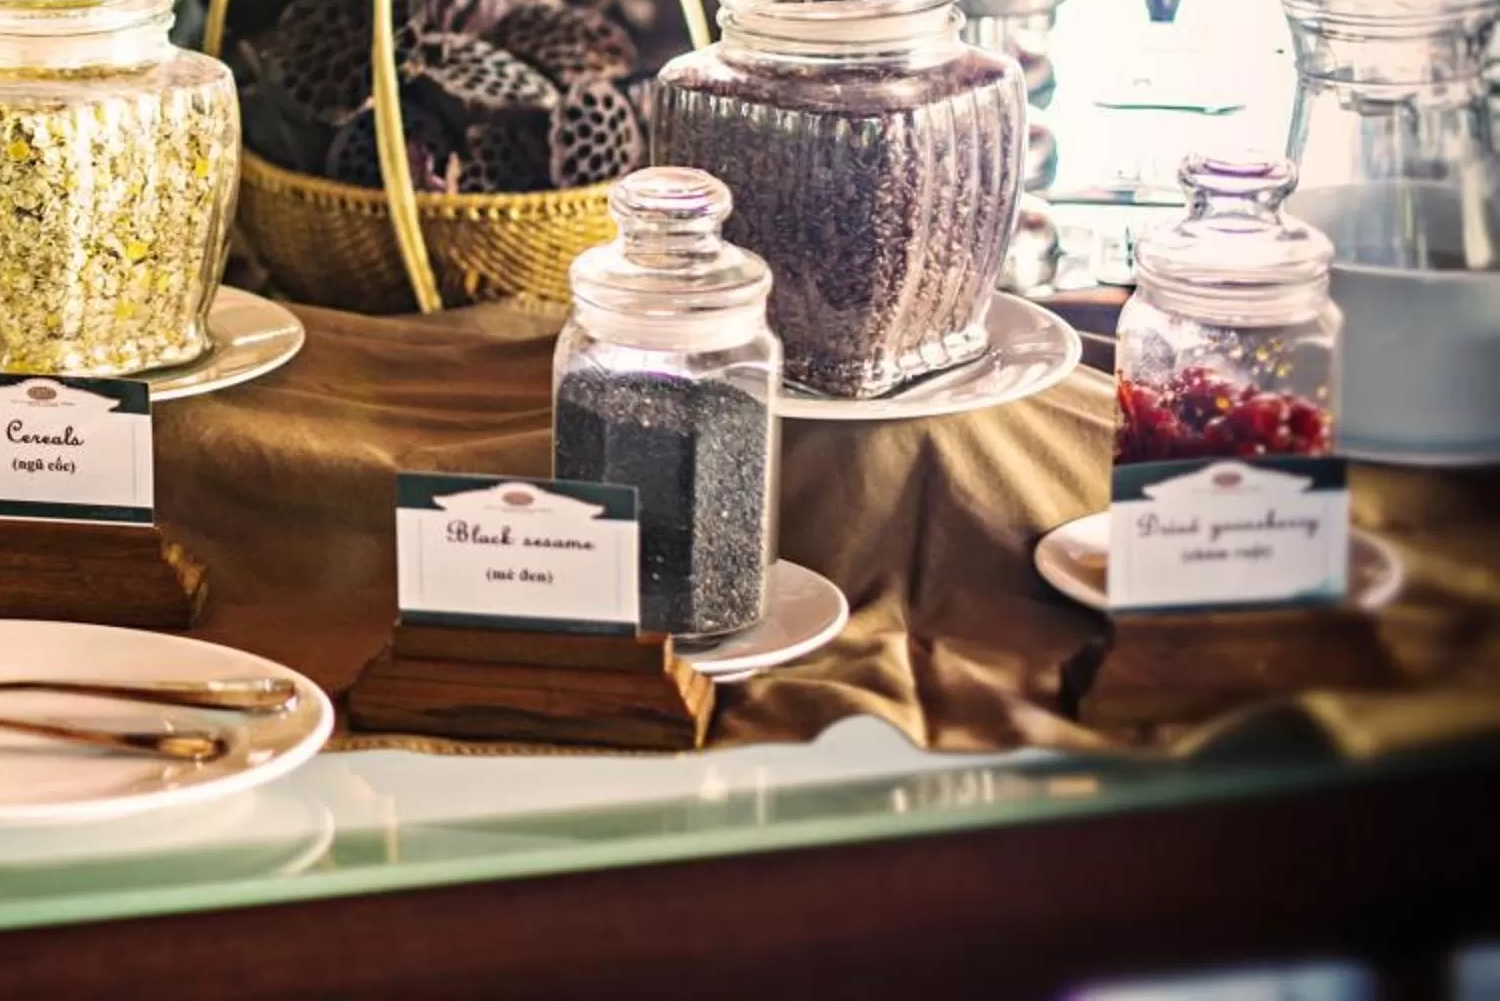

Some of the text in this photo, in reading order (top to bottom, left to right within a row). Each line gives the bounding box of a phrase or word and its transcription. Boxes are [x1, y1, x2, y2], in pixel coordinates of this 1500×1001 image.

[6, 419, 84, 446] Cereals
[447, 520, 596, 551] Black sesame
